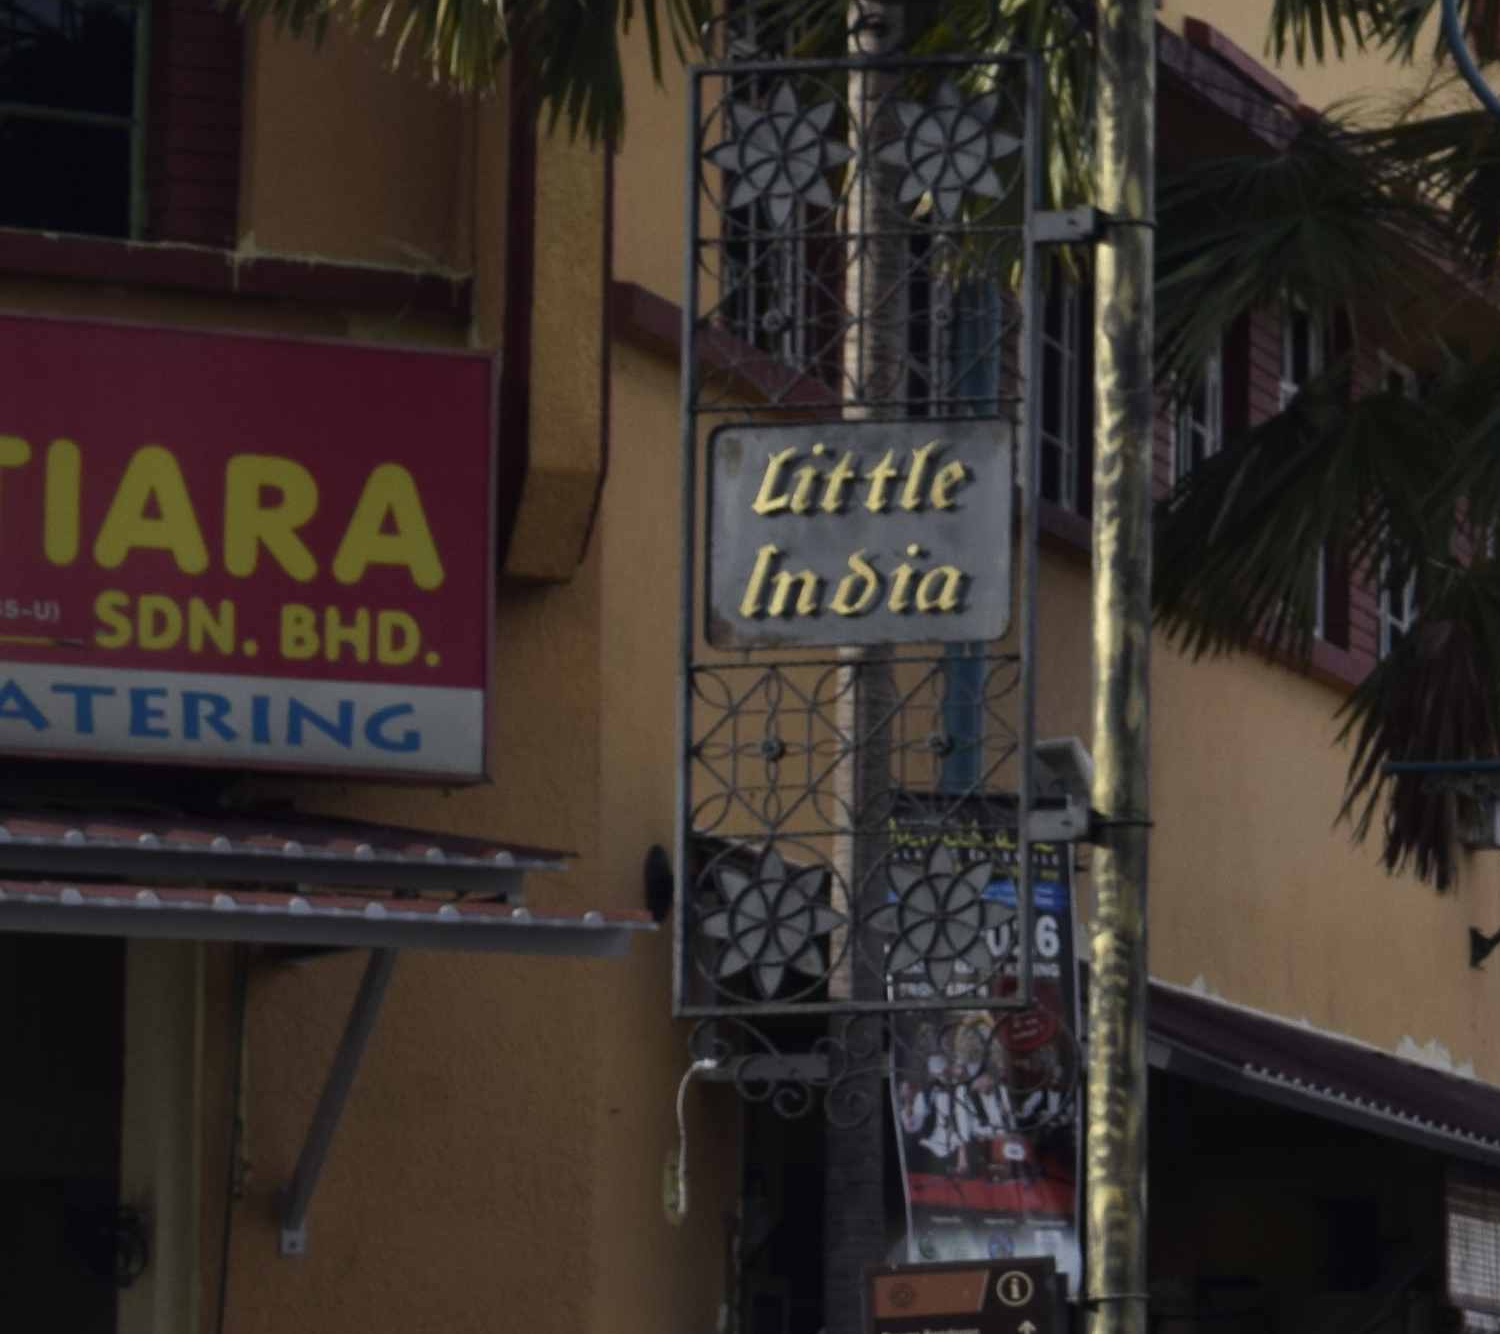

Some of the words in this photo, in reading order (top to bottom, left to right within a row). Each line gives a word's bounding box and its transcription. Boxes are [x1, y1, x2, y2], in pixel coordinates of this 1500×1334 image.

[753, 439, 967, 515] Little
[738, 543, 964, 618] India
[94, 588, 260, 657] SDN.
[279, 603, 440, 668] BHD.
